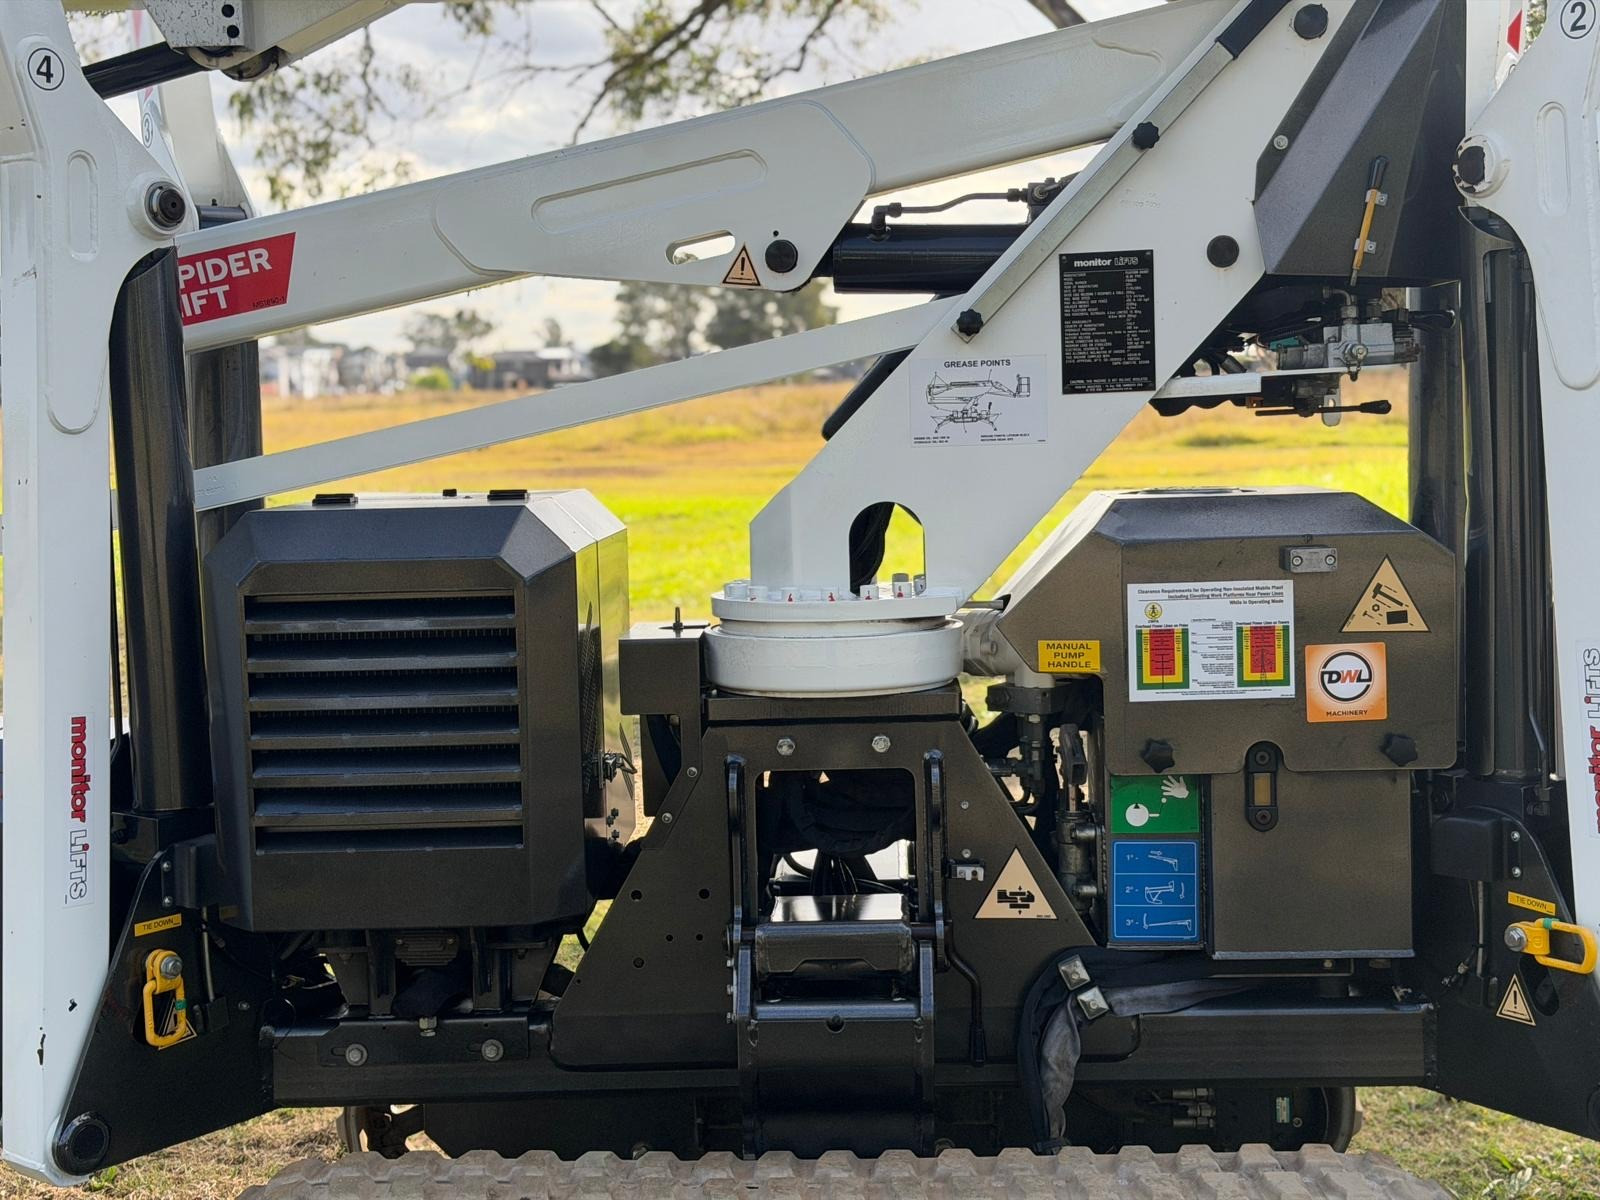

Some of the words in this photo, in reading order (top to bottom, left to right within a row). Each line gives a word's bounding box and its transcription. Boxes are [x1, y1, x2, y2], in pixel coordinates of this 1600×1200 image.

[1569, 1, 1587, 33] 2
[36, 55, 54, 84] 4
[144, 117, 151, 143] 3
[178, 247, 273, 289] PIDER
[1073, 257, 1112, 267] monitor
[181, 284, 230, 318] IFT
[943, 360, 979, 368] GREASE
[980, 359, 1011, 367] POINTS
[1321, 669, 1372, 684] DWL
[1326, 709, 1368, 717] MACHINERY
[70, 715, 91, 823] monitor
[1588, 725, 1600, 834] itor
[1516, 895, 1526, 905] TIE
[1526, 899, 1547, 910] DOWN
[143, 923, 152, 931] TIE
[153, 917, 174, 928] DOWN
